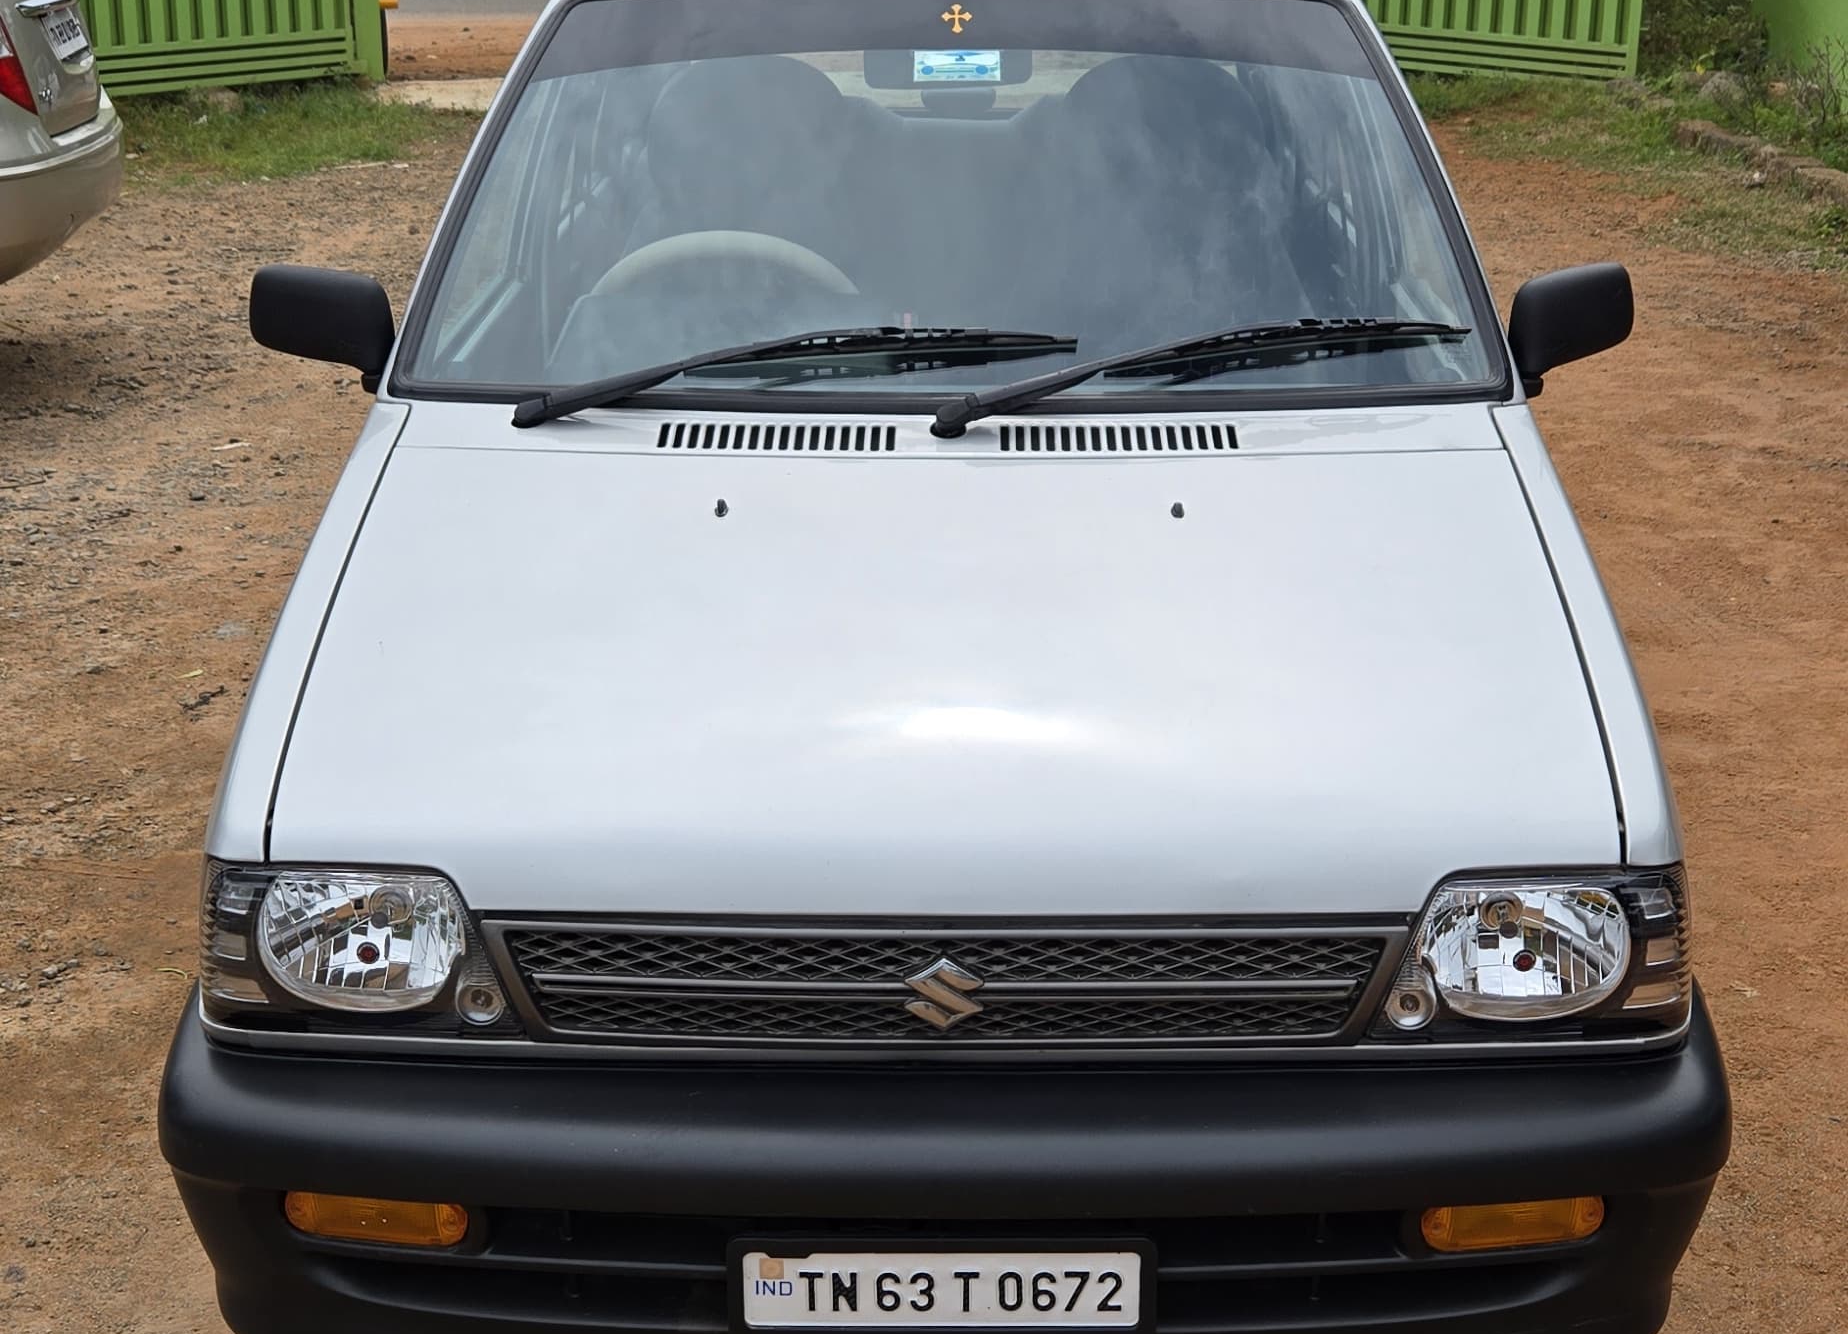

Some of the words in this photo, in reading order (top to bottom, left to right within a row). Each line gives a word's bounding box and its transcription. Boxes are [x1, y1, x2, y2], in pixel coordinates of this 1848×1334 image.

[755, 1280, 793, 1297] IND
[798, 1271, 858, 1312] TN
[875, 1271, 936, 1312] 63
[954, 1271, 980, 1312] T
[998, 1271, 1123, 1312] 0672
